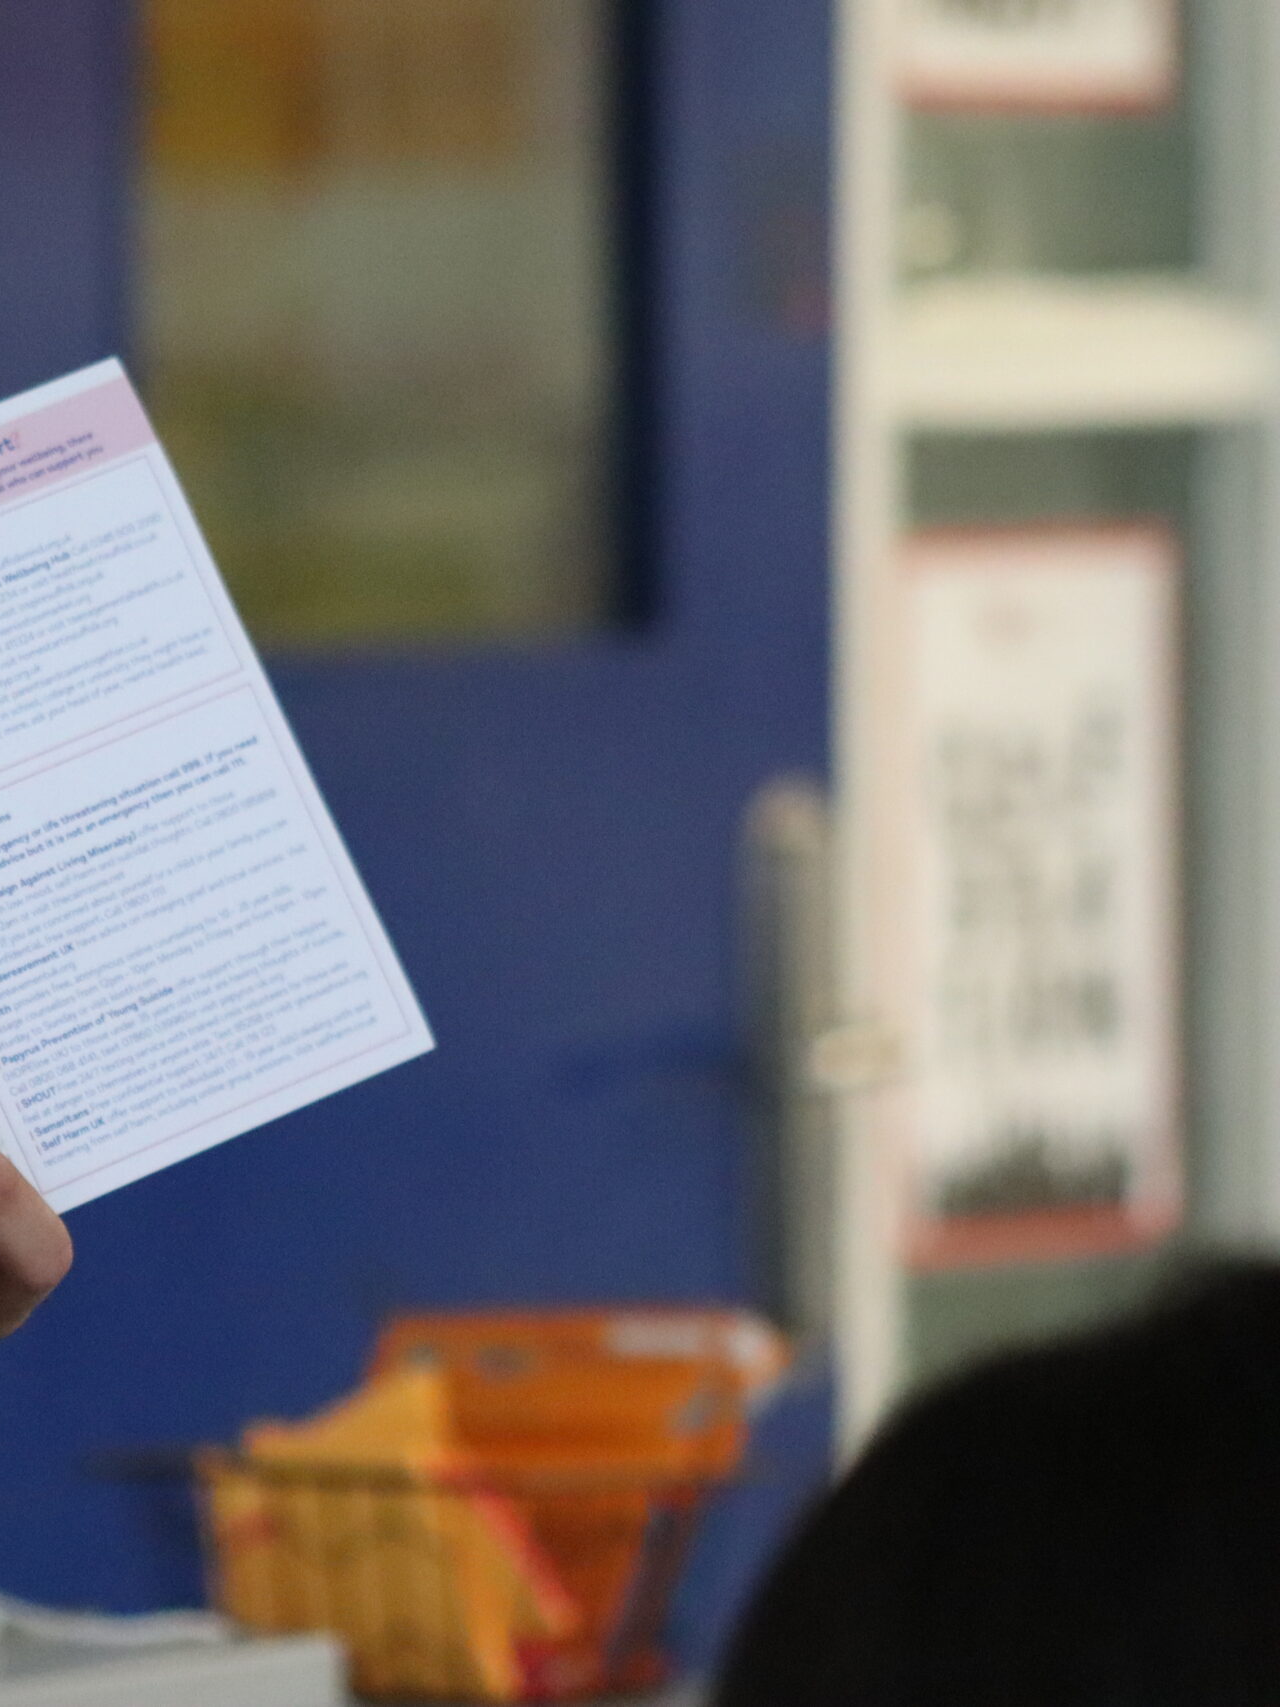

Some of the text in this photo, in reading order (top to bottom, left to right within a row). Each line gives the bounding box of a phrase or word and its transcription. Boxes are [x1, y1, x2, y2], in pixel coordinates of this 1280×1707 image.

[66, 432, 93, 447] there
[7, 476, 27, 489] who
[29, 469, 45, 480] can
[47, 451, 83, 473] support
[3, 561, 50, 584] Wellbeing
[51, 551, 70, 565] Hub
[43, 822, 59, 832] life
[61, 797, 118, 825] threatening
[120, 778, 161, 800] situation
[164, 769, 180, 782] call
[217, 748, 233, 761] you
[27, 843, 44, 856] but
[67, 826, 82, 839] not
[98, 800, 151, 826] emergency
[151, 790, 174, 803] then
[176, 782, 193, 795] you
[195, 774, 211, 785] can
[214, 764, 230, 777] call
[20, 866, 55, 887] Against
[58, 855, 87, 871] Living
[88, 832, 137, 858] Miserably)
[1, 1044, 39, 1065] Papyrus
[41, 1021, 93, 1047] Prevention
[108, 1002, 138, 1019] Young
[139, 987, 173, 1005] Suicide
[22, 1087, 56, 1108] SHOUT
[35, 1109, 88, 1136] Samaritans
[42, 1135, 62, 1150] Self
[64, 1125, 89, 1140] Harm
